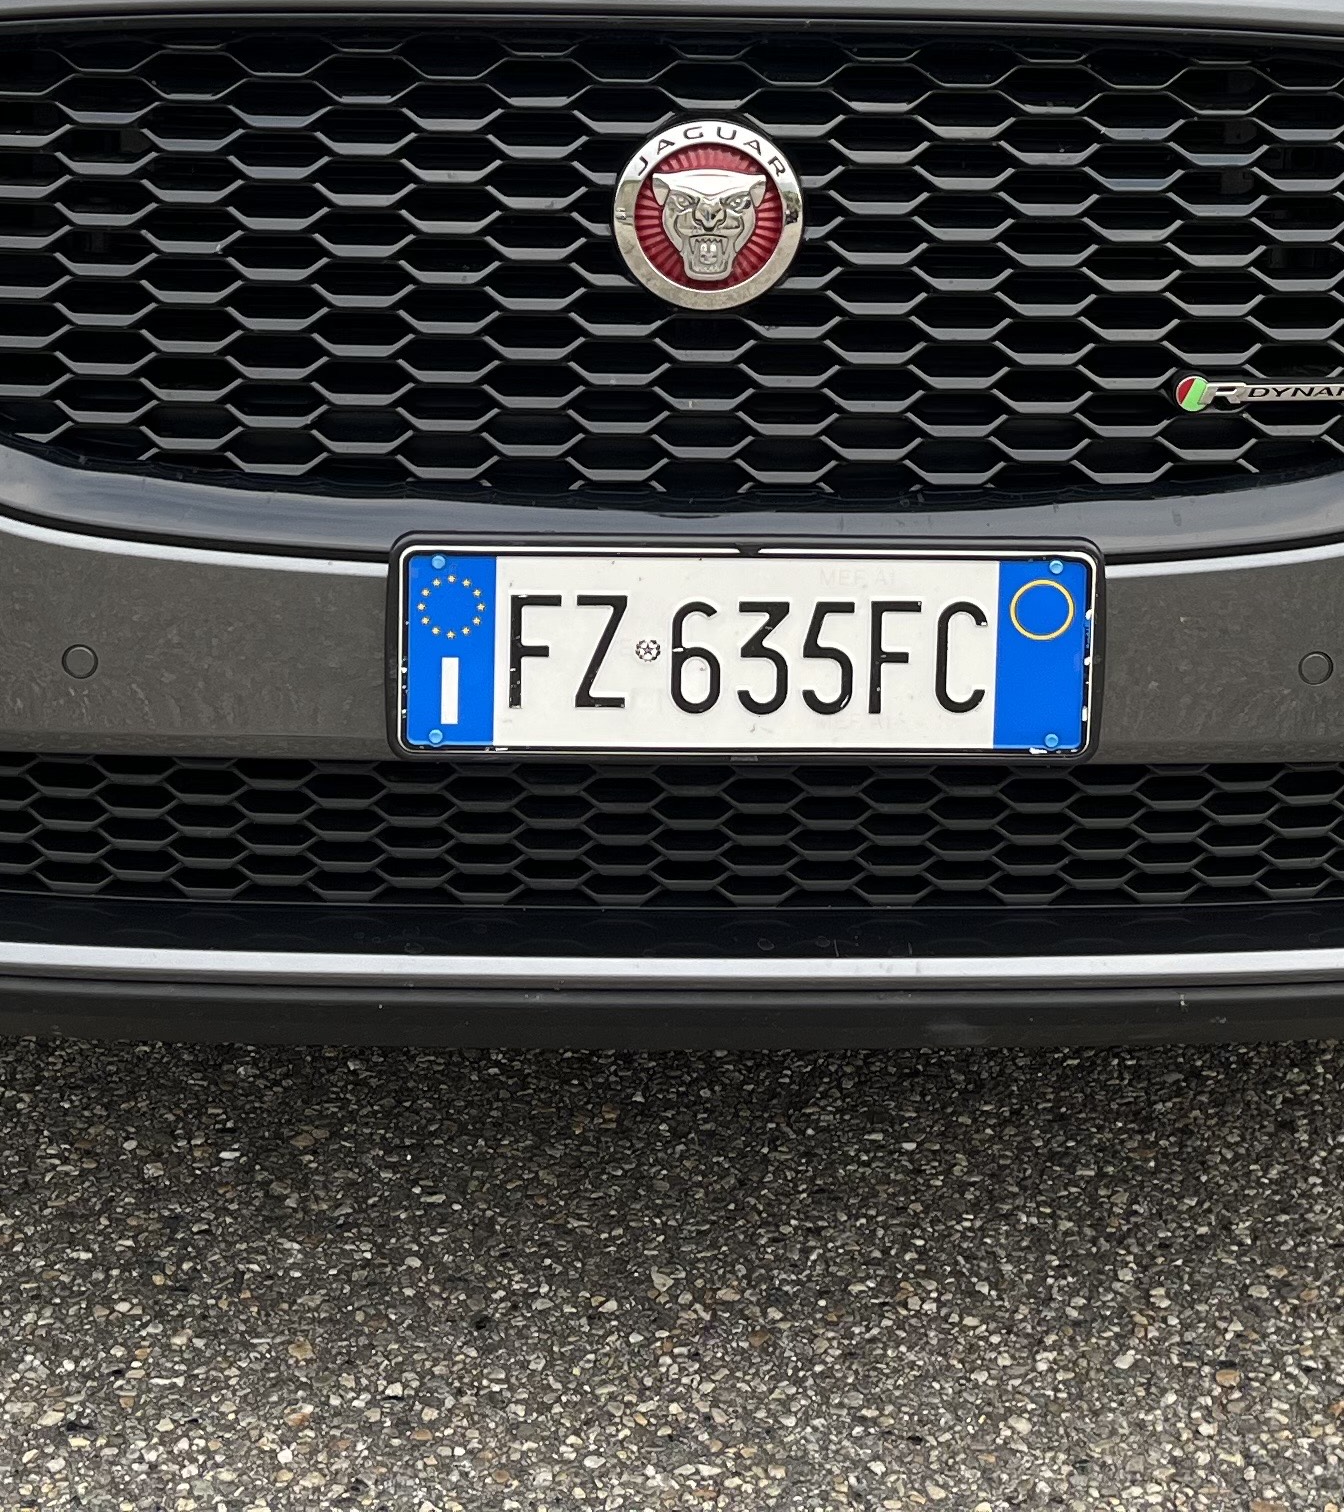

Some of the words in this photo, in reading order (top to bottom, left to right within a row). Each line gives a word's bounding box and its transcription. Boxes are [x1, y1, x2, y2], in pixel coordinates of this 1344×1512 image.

[637, 125, 787, 178] JAGUAR
[508, 593, 629, 709] FZ
[670, 600, 988, 716] 635FC
[441, 657, 459, 725] I
